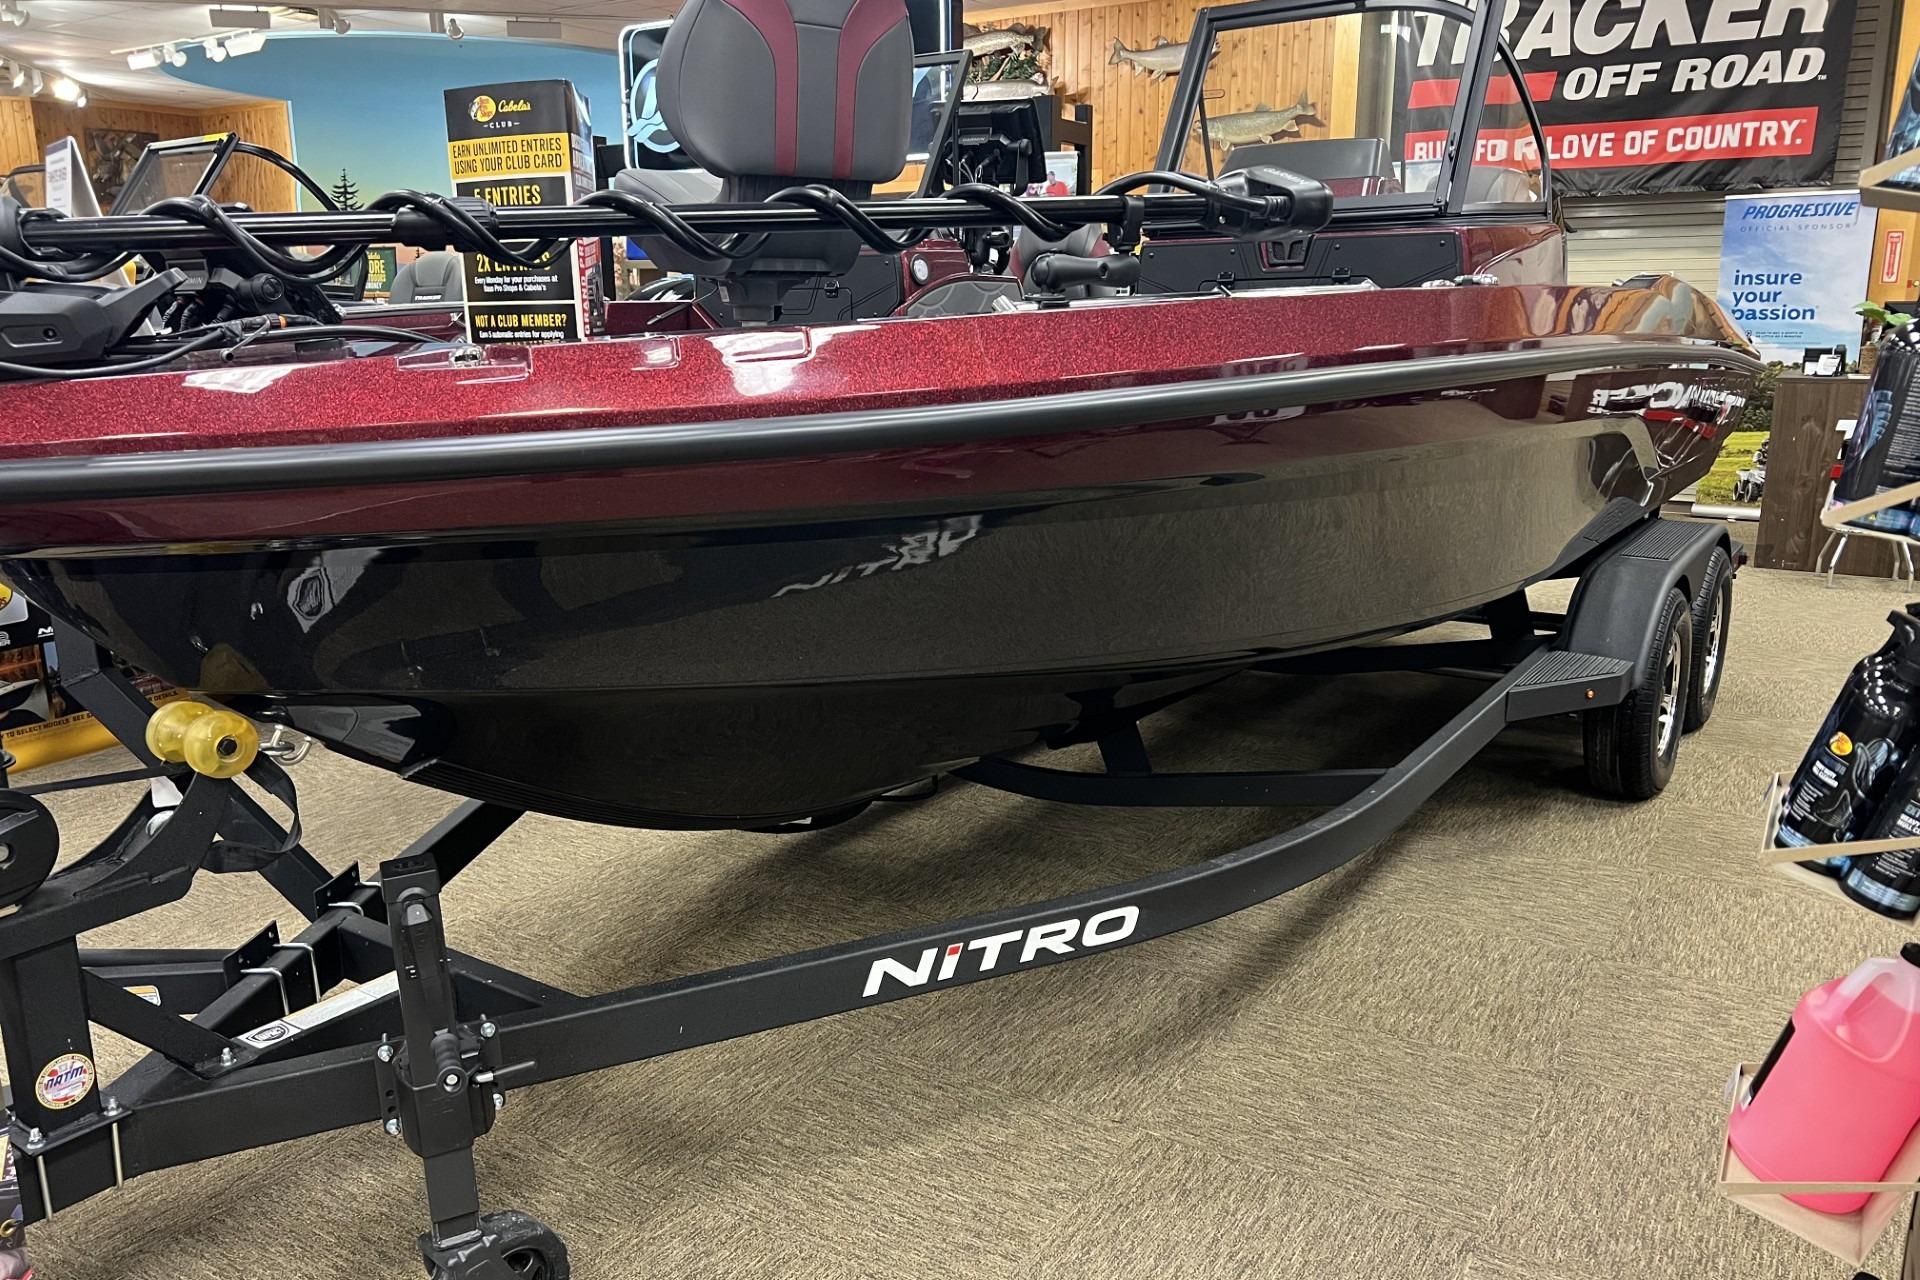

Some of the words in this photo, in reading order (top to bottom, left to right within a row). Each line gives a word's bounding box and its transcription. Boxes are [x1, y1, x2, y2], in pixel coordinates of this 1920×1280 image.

[1562, 62, 1662, 101] OFF
[1671, 47, 1826, 94] ROAD
[489, 120, 513, 129] CLUB
[452, 144, 472, 159] EARN
[472, 140, 518, 157] UNLIMITED
[521, 137, 562, 153] ENTRIES
[1546, 132, 1614, 160] LOVE
[1626, 130, 1657, 155] OF
[1666, 119, 1803, 151] COUNTRY.
[454, 159, 478, 175] USING
[480, 156, 503, 172] YOUR
[506, 154, 531, 170] CLUB
[484, 184, 542, 207] ENTRIES
[1741, 201, 1859, 221] PROGRESSIVE
[1739, 225, 1791, 234] OFFICIAL
[1797, 222, 1851, 232] SPONSOR
[576, 237, 586, 269] PRI
[368, 259, 386, 274] ORE
[476, 253, 491, 273] 2X
[511, 276, 523, 285] your
[523, 275, 551, 284] purchases
[1734, 269, 1803, 286] insure
[1732, 289, 1782, 308] your
[475, 314, 488, 328] NOT
[490, 314, 497, 327] A
[497, 313, 519, 328] CLUB
[521, 313, 568, 327] MEMBER?
[1731, 304, 1816, 321] passion
[541, 330, 565, 339] applying
[862, 905, 1140, 998] NITRO
